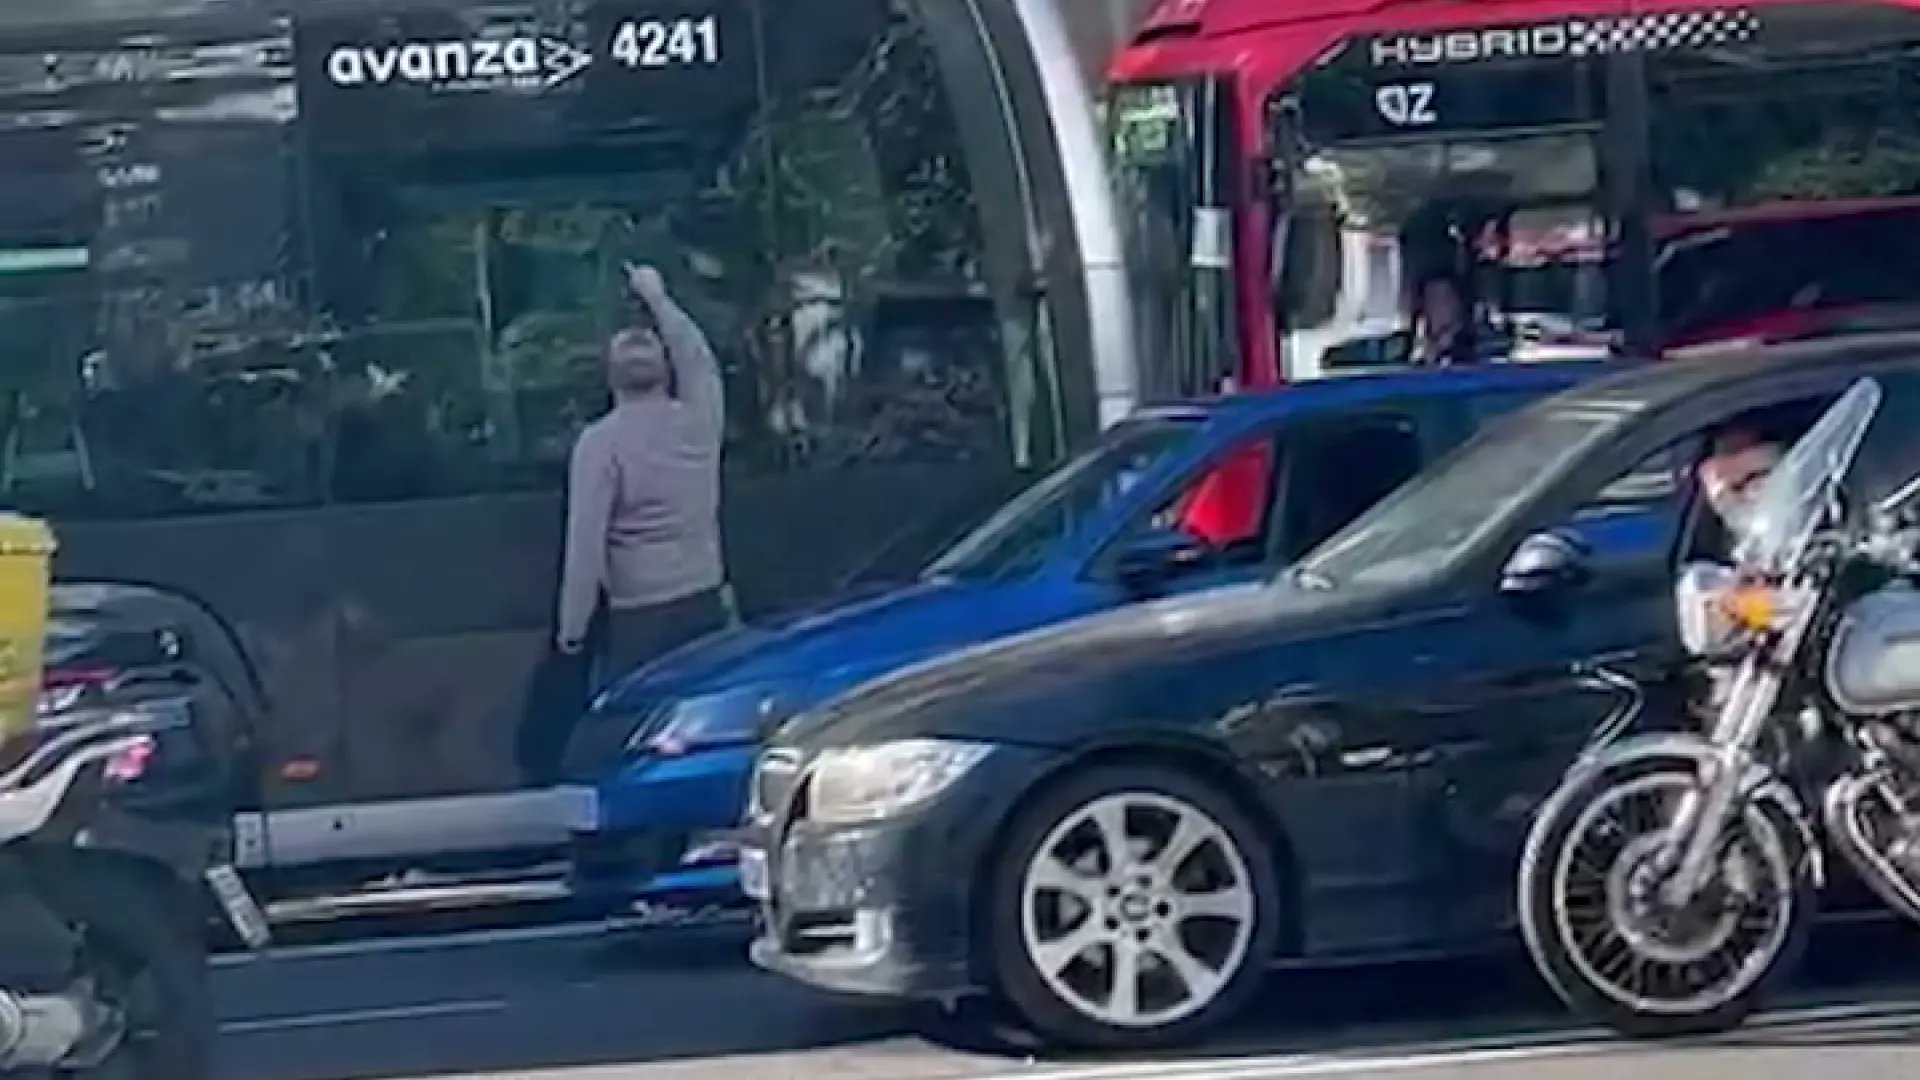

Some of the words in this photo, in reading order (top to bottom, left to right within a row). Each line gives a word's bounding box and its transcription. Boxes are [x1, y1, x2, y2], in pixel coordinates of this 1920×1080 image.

[328, 37, 541, 84] avanza
[612, 15, 719, 67] 4241
[1372, 25, 1566, 65] HYBRID
